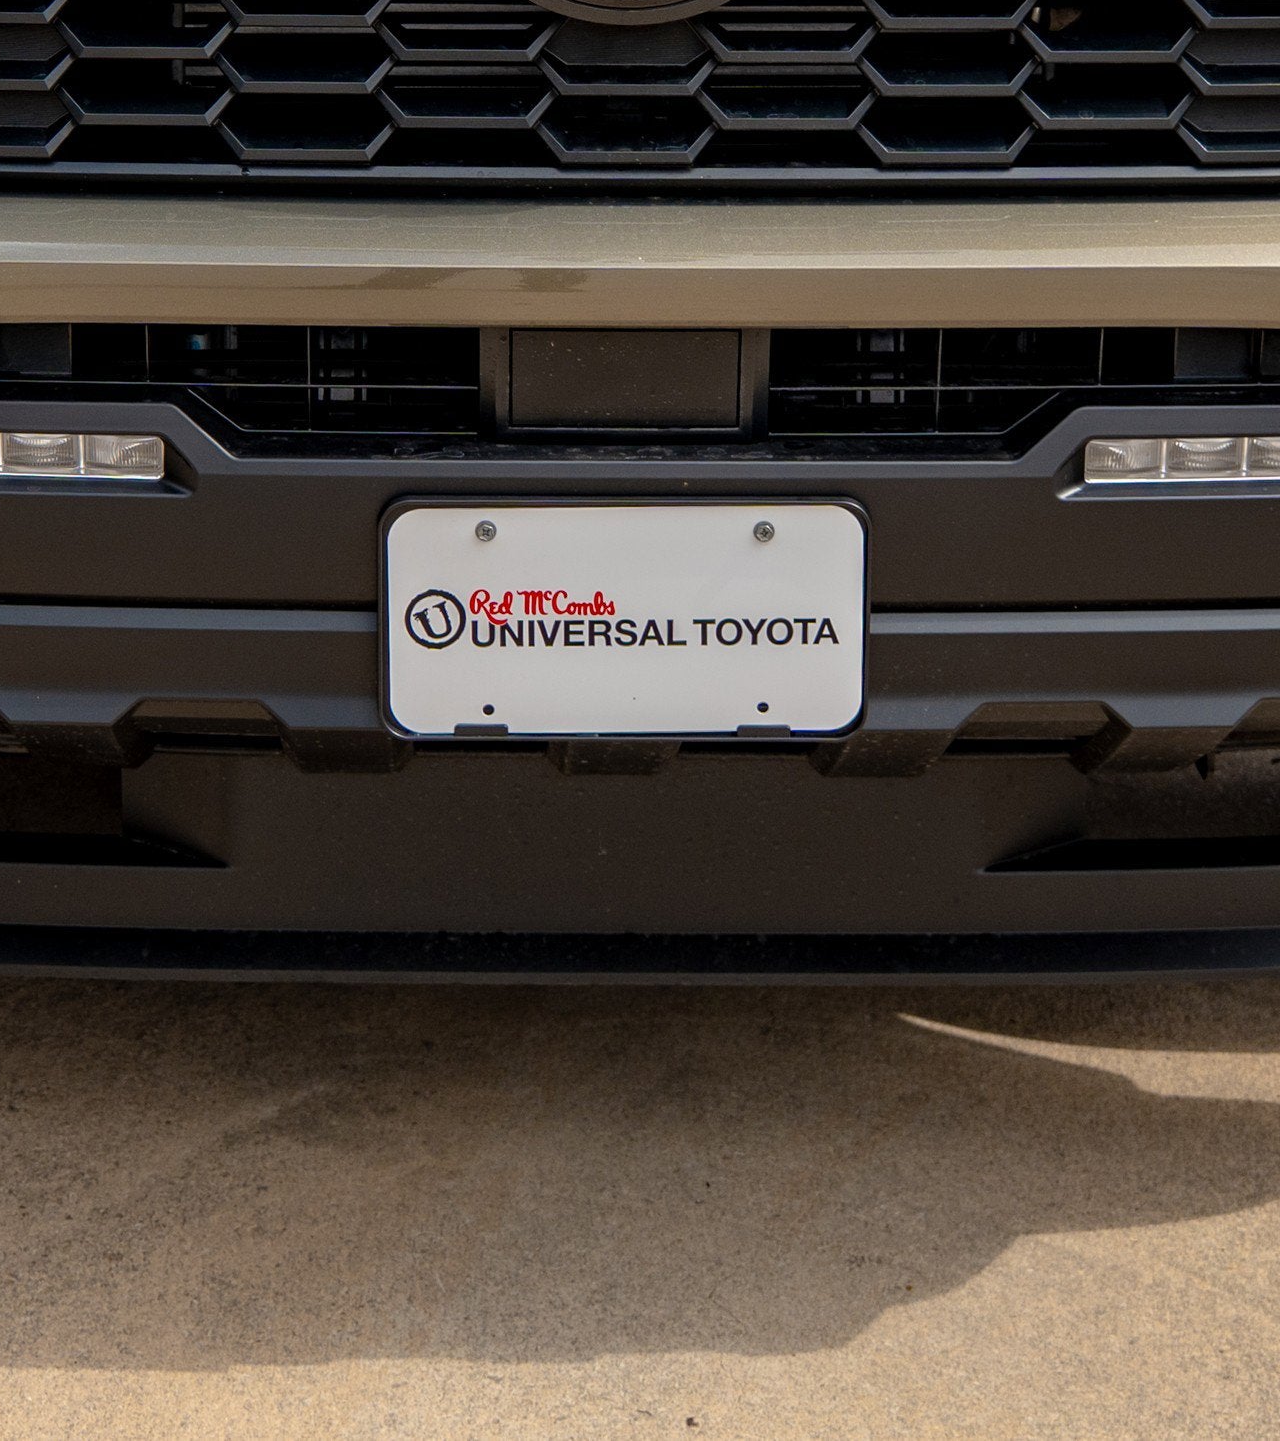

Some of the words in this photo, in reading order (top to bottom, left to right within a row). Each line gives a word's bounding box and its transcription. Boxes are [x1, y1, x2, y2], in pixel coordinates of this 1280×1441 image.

[469, 589, 514, 625] Red
[517, 590, 616, 616] McCombs
[471, 618, 687, 648] UNIVERSAL
[692, 618, 840, 646] TOYOTA
